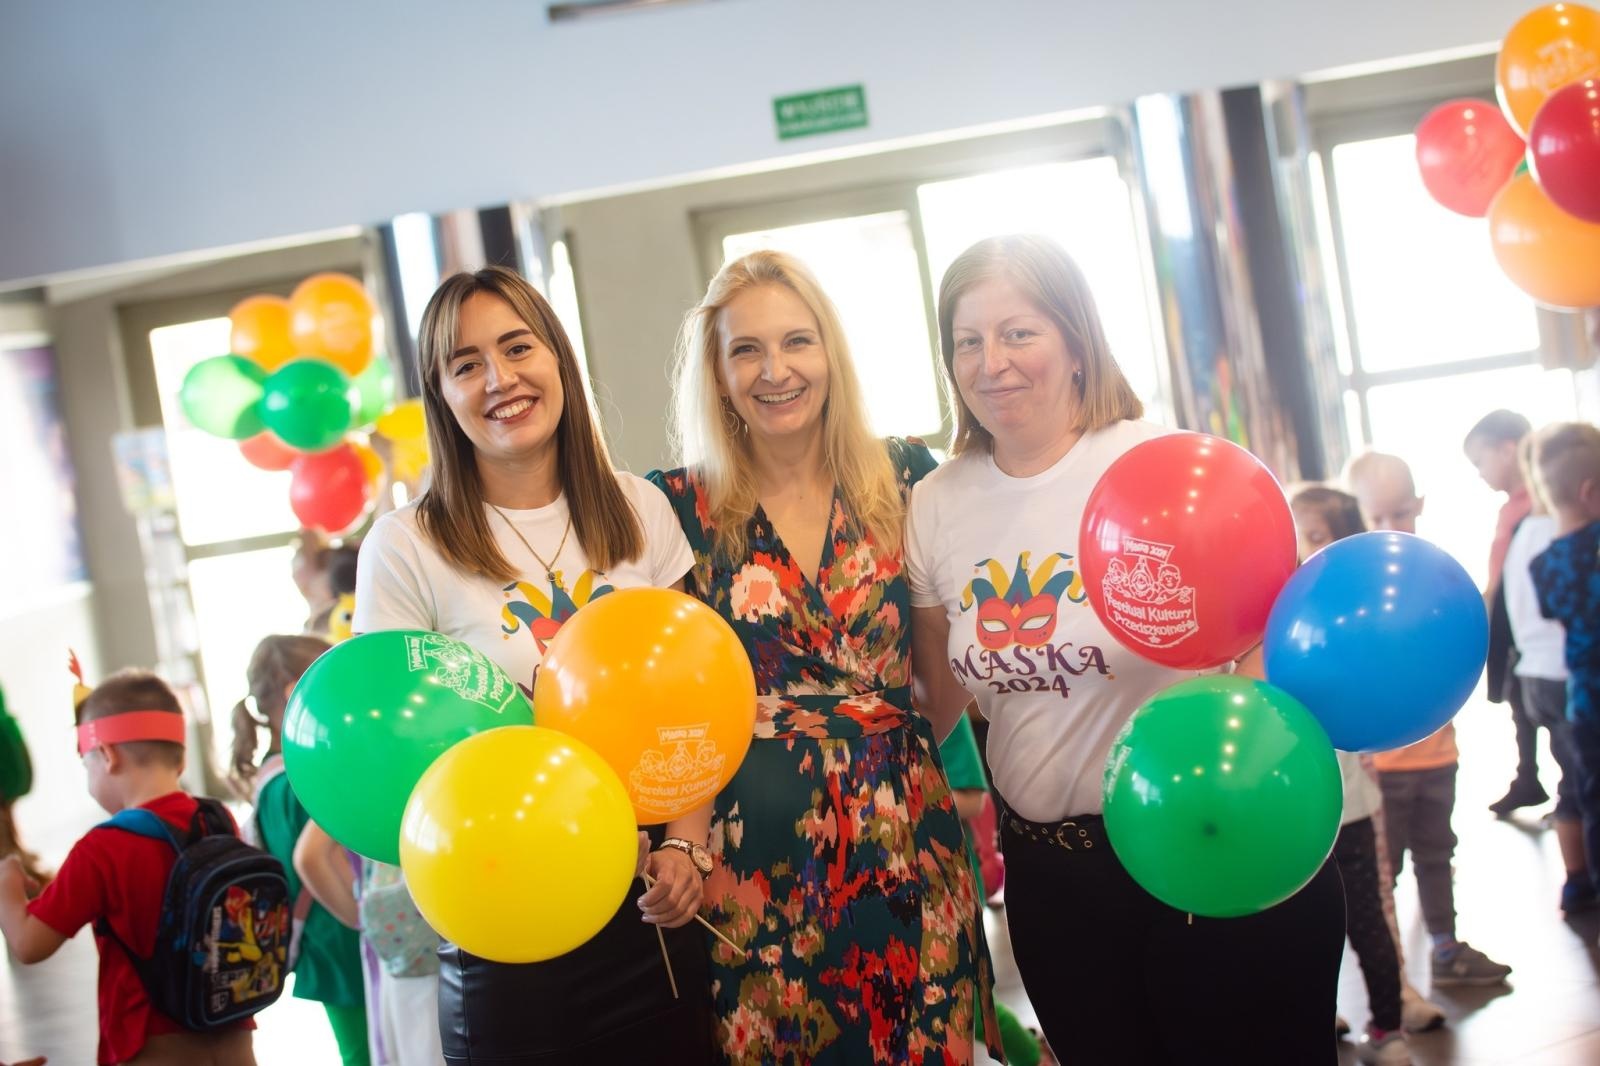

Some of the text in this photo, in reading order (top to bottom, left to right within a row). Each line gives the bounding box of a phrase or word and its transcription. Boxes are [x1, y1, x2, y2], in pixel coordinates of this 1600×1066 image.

[1148, 606, 1191, 622] Kultury
[951, 642, 1110, 687] MASKA
[988, 674, 1070, 699] 2024
